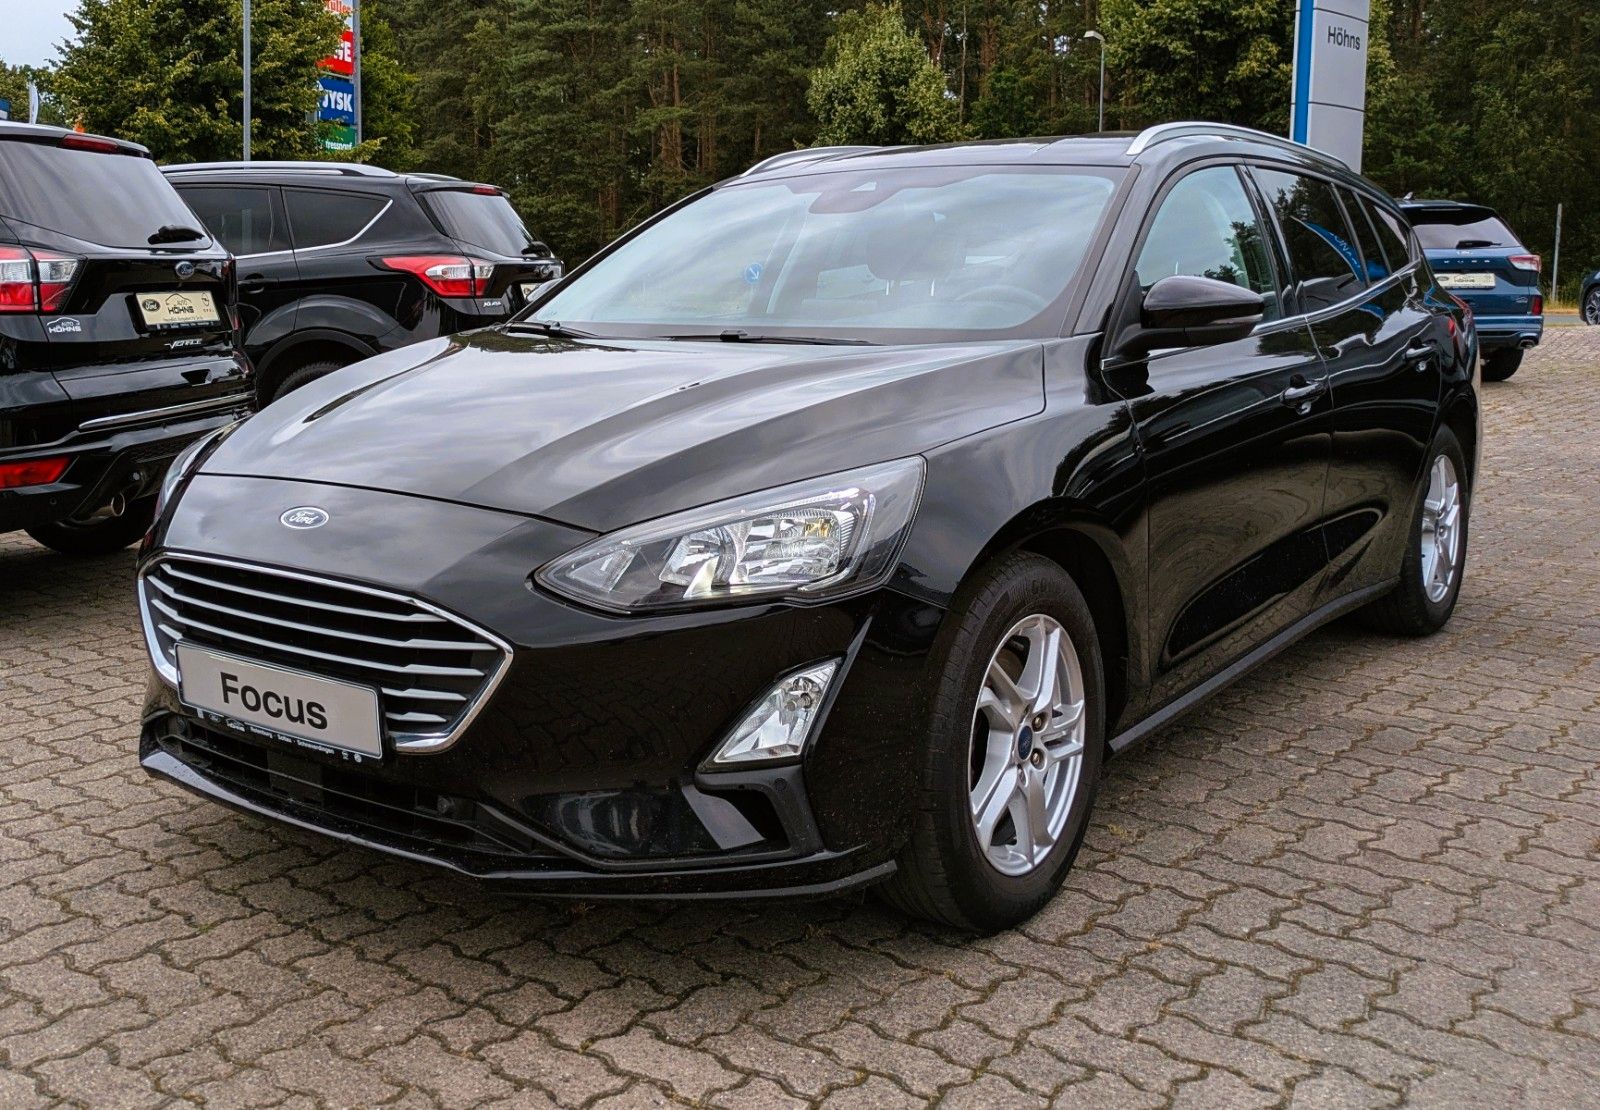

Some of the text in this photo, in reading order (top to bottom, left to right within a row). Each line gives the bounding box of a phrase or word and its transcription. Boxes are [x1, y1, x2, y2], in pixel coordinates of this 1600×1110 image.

[1327, 25, 1361, 51] Höhns
[322, 89, 353, 113] JYSK
[168, 305, 195, 314] HÖHNS
[220, 671, 328, 730] Focus
